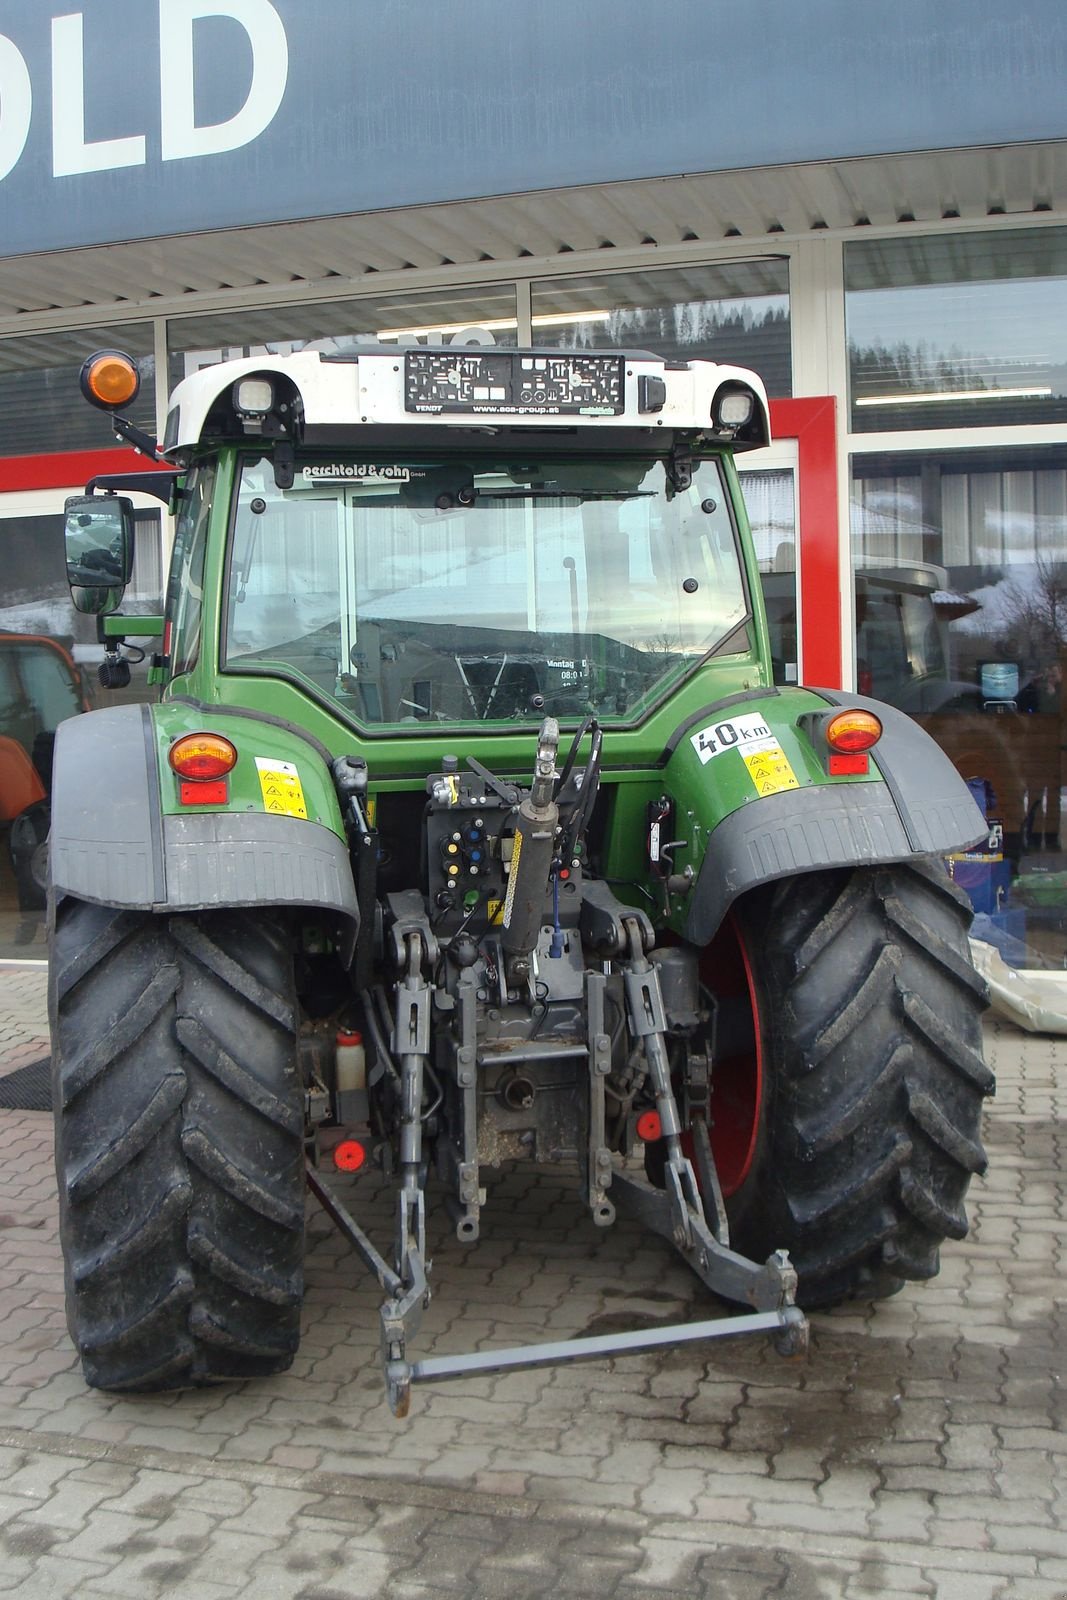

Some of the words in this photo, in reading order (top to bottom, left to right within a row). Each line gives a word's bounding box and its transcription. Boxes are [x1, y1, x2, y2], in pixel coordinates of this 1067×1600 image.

[0, 0, 289, 181] LD
[699, 723, 739, 754] 40
[742, 725, 769, 739] km
